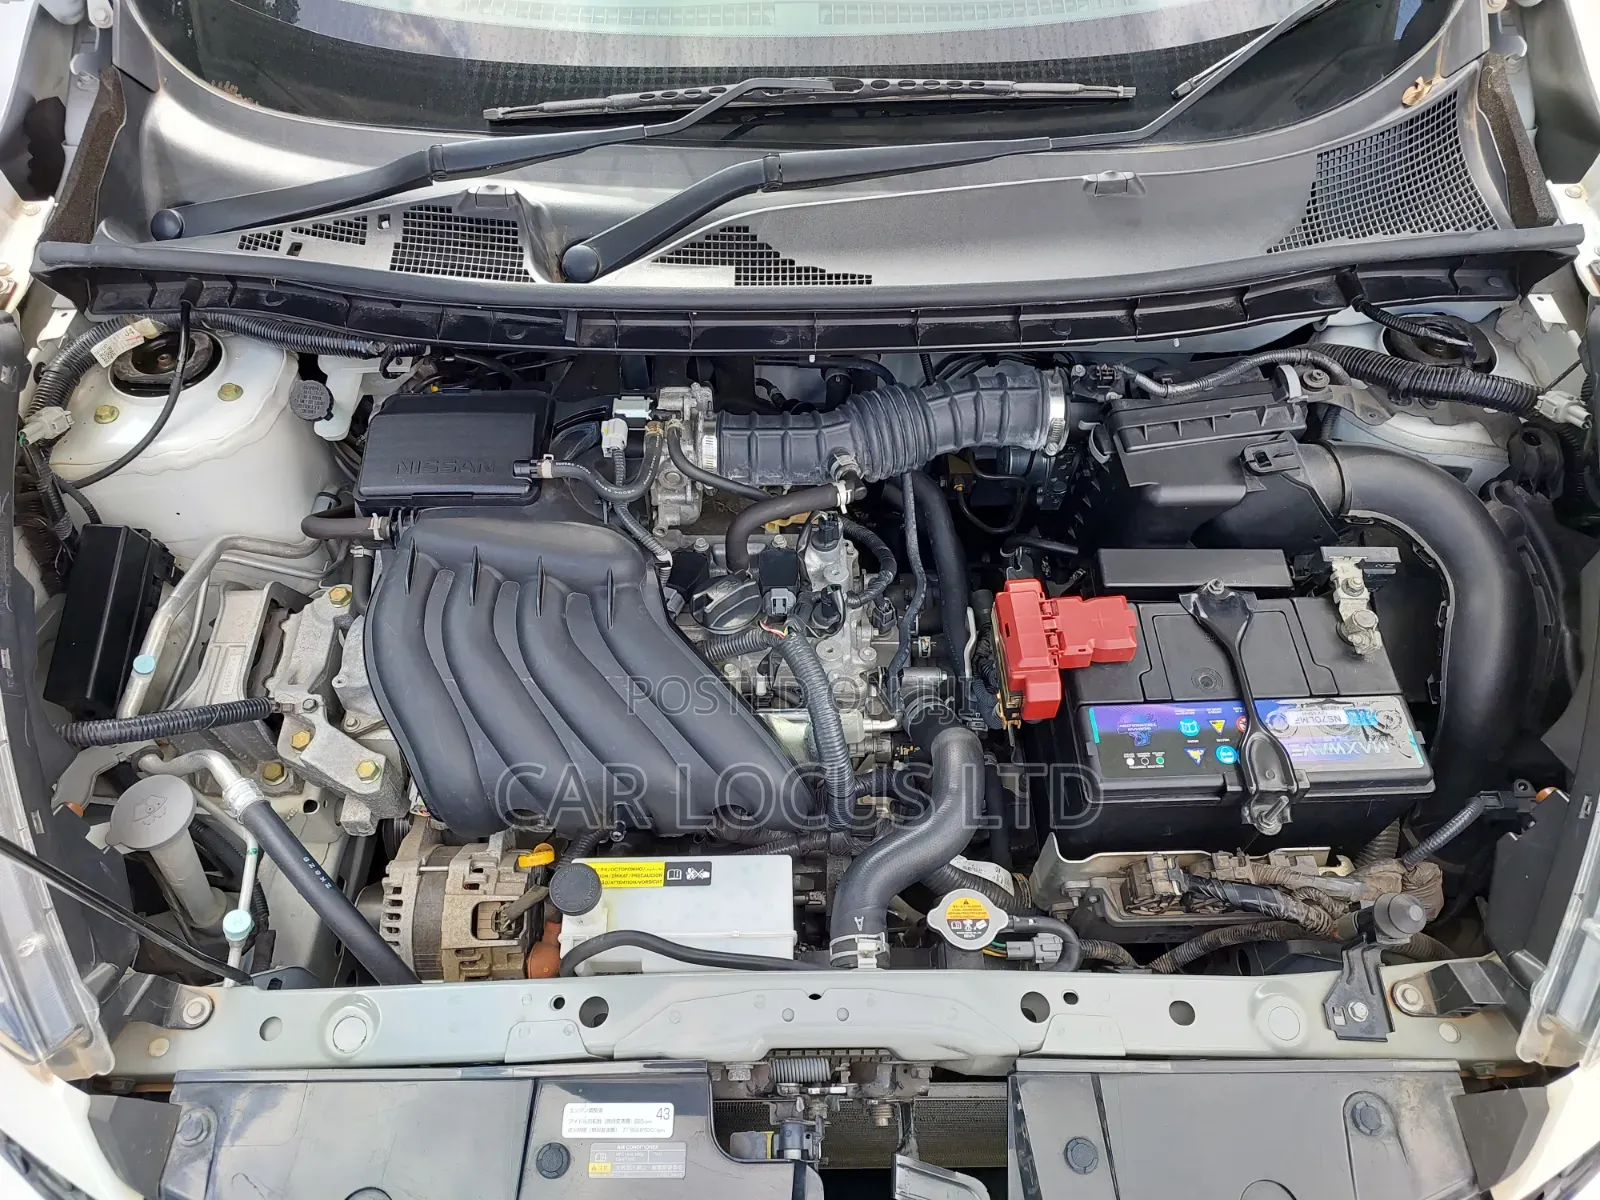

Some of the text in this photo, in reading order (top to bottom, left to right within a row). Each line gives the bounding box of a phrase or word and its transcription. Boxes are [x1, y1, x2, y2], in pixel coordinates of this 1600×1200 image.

[396, 460, 495, 475] NISSAN
[1289, 740, 1391, 757] MAXWAVE
[655, 1107, 671, 1121] 43
